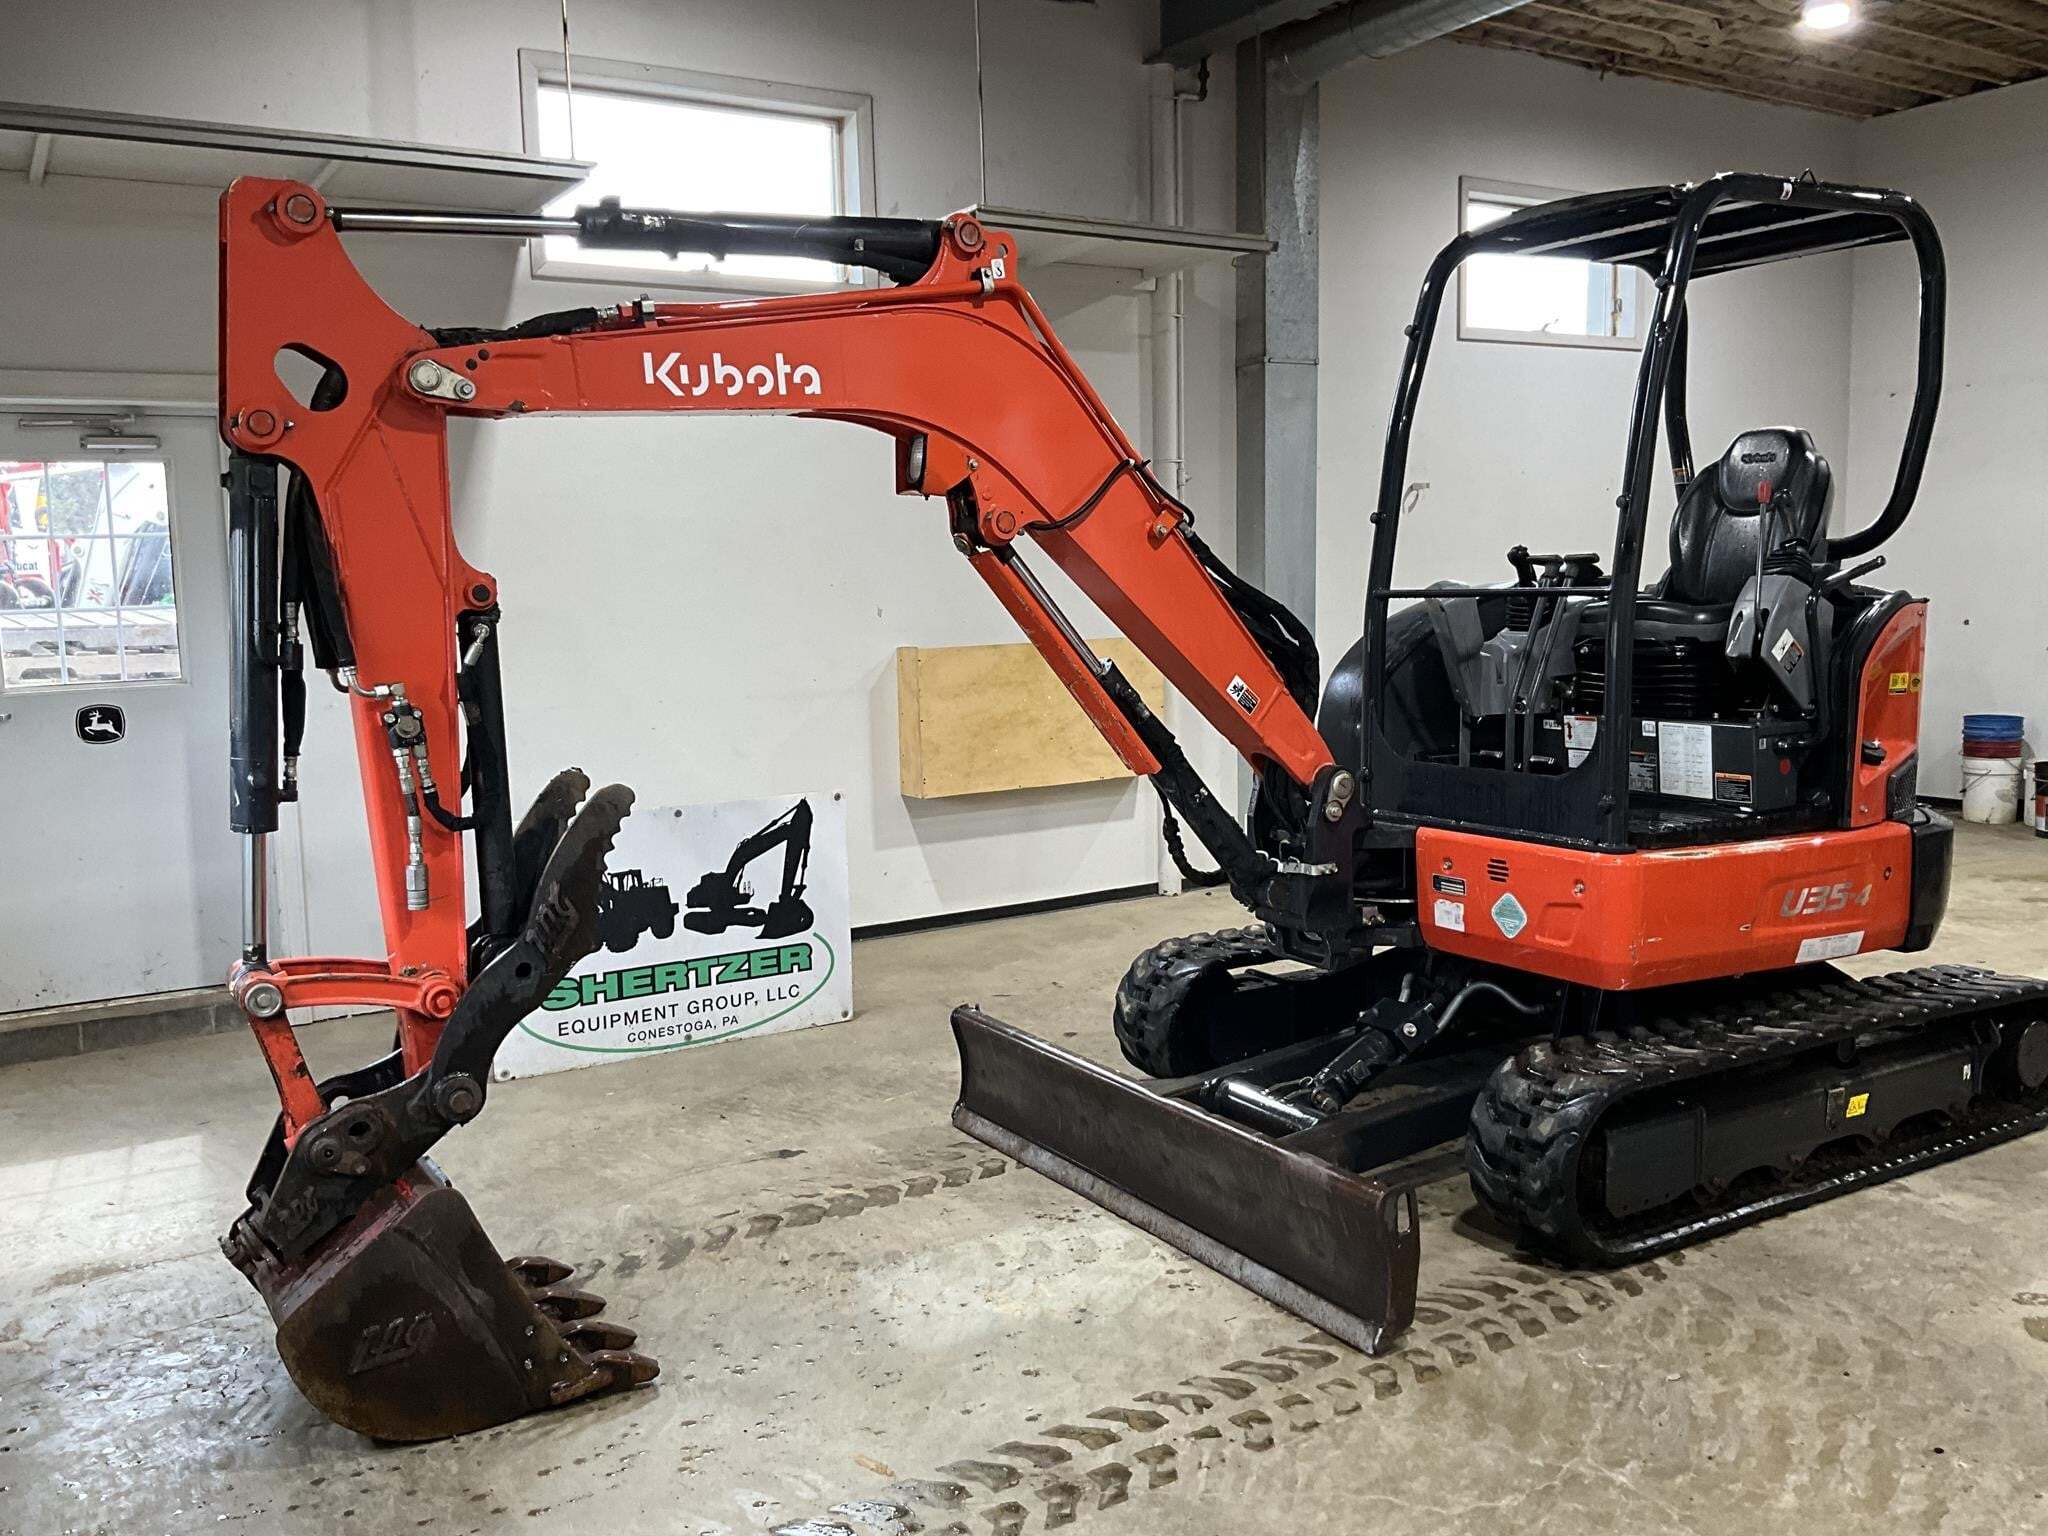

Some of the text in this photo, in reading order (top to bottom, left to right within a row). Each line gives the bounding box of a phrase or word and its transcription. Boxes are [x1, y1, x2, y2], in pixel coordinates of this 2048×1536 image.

[643, 352, 821, 396] Kubota
[1780, 881, 1873, 917] U35-4
[541, 943, 812, 1011] SHERTZER
[558, 984, 800, 1037] EQUIPMENT GROUP, LLC
[627, 1014, 739, 1043] CONESTOGA, PA
